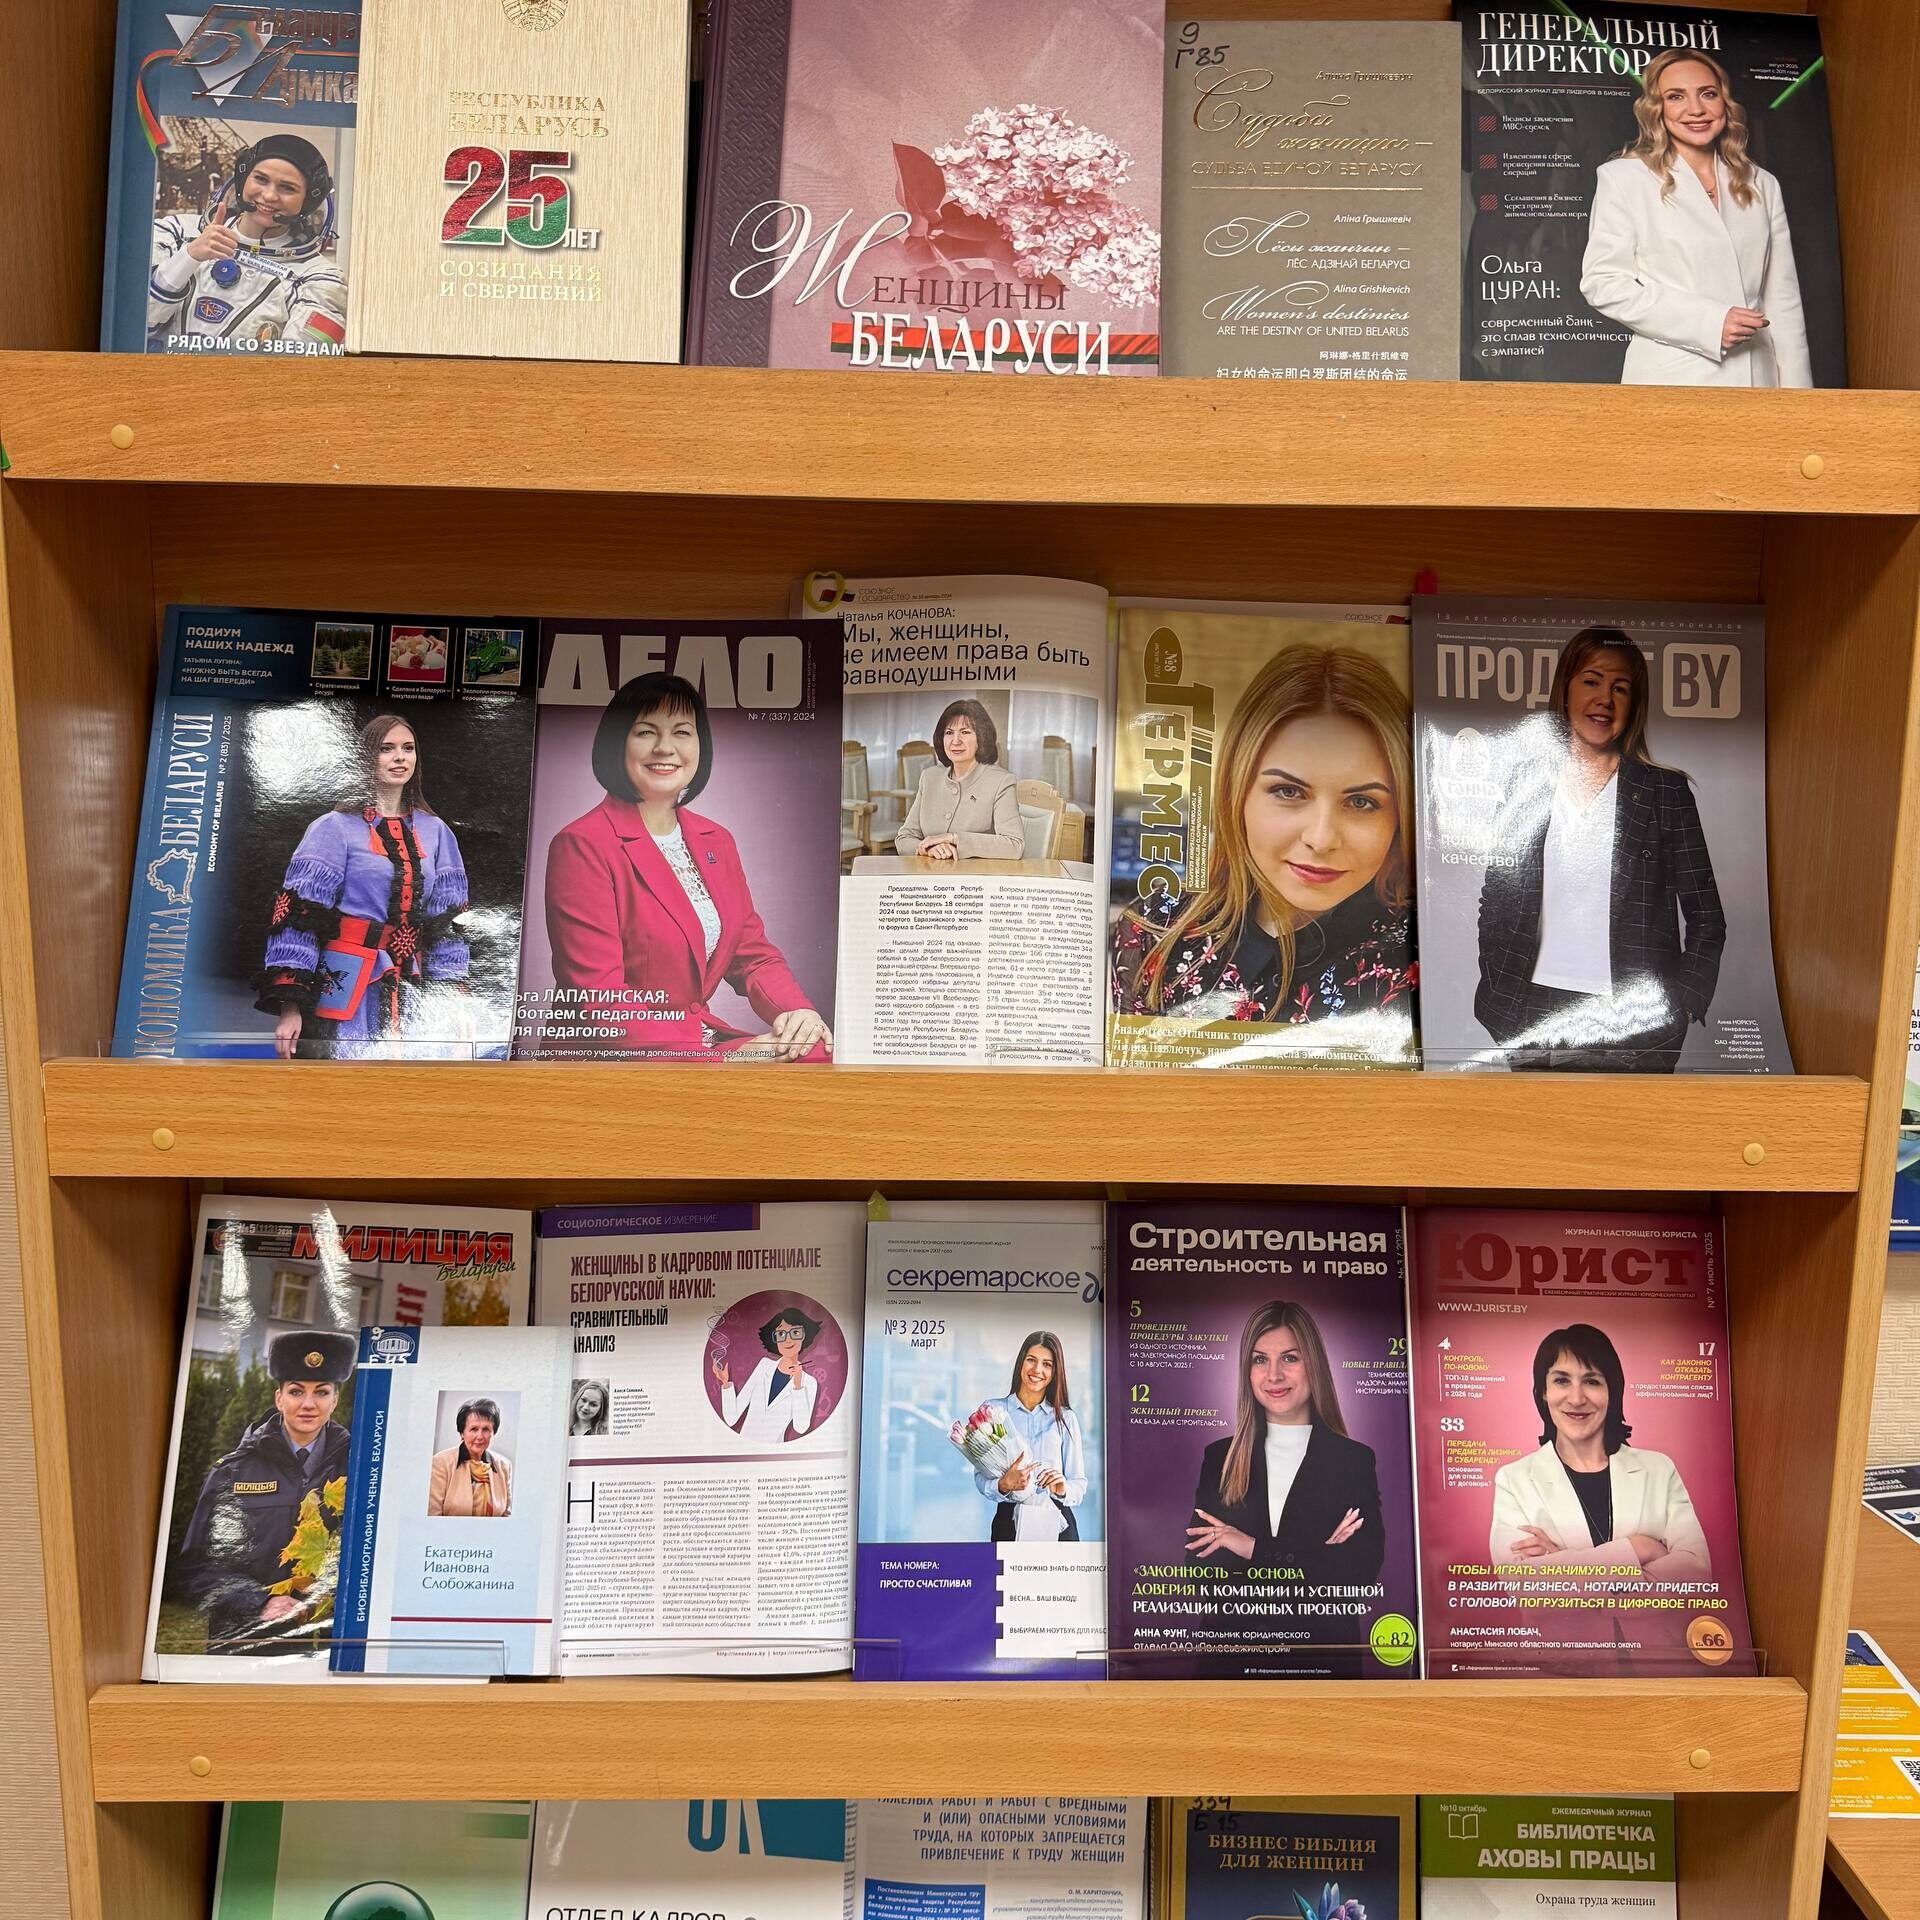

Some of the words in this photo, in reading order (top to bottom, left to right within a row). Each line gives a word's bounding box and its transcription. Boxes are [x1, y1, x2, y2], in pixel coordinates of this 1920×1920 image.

[1180, 22, 1199, 44] 9
[1478, 12, 1721, 50] ГЕНЕРАЛЬНЫЙ
[1477, 44, 1651, 78] ДИРЕКТОР
[448, 91, 606, 112] РЕСПУБЛИКА
[448, 112, 609, 137] БЕЛАРУСЬ
[1263, 160, 1332, 176] ЕДИНОЙ
[1339, 162, 1423, 176] БЕЛАРУСИ
[441, 145, 570, 249] 25
[562, 228, 601, 250] ЛЕТ
[1334, 214, 1360, 223] Аліна
[1363, 215, 1411, 224] Грышкевіч
[440, 259, 602, 282] СОЗИДАНИЯ
[1311, 258, 1357, 270] АДЗІНАЙ
[1361, 259, 1410, 269] БЕЛАРУСІ
[1481, 255, 1542, 275] Ольга
[463, 281, 602, 302] СВЕРШЕНИЙ
[1334, 285, 1357, 293] Alina
[1359, 285, 1410, 294] Grishkevich
[1481, 280, 1562, 305] ЦУРАН:
[1203, 281, 1329, 321] Women's
[1323, 304, 1409, 320] destinies
[1217, 326, 1235, 335] ARE
[1241, 326, 1259, 336] THE
[1263, 326, 1303, 336] DESTINY
[1307, 326, 1322, 336] OF
[1326, 326, 1361, 336] UNITED
[1366, 327, 1409, 336] BELARUS
[1481, 316, 1563, 332] современный
[1566, 314, 1592, 327] банк
[168, 335, 231, 352] РЯДОМ
[850, 311, 1111, 375] БЕЛАРУСИ
[1481, 332, 1500, 343] это
[1504, 331, 1536, 342] сплав
[1539, 331, 1635, 342] технологичности
[1491, 345, 1545, 356] эмпатией
[837, 611, 884, 622] Наталья
[888, 608, 956, 620] КОЧАНОВА:
[186, 627, 241, 638] ПОДИУМ
[889, 622, 1009, 641] женщины,
[185, 638, 232, 651] НАШИХ
[236, 641, 295, 655] НАДЕЖД
[871, 646, 948, 662] имеем
[957, 644, 1028, 663] права
[1037, 640, 1090, 666] быть
[1672, 653, 1731, 708] BY
[769, 713, 790, 721] (337)
[793, 713, 815, 721] 2024
[159, 713, 214, 847] БЕЛАРУСИ
[208, 838, 218, 872] ECONOMY
[214, 780, 224, 818] BELARUS
[1441, 852, 1520, 868] качество!
[542, 989, 670, 1004] ЛАПАТИНСКАЯ:
[591, 1010, 685, 1021] педагогами
[594, 1049, 645, 1057] учреждения
[558, 1216, 662, 1229] СОЦИОЛОГИЧЕСКОЕ
[664, 1215, 717, 1224] ИЗМЕРЕНИЕ
[1129, 1223, 1387, 1254] Строительная
[1565, 1228, 1601, 1236] ЖУРНАЛ
[1603, 1229, 1660, 1238] НАСТОЯЩЕГО
[292, 1225, 513, 1265] МИЛИЦИЯ
[570, 1253, 644, 1277] ЖЕНЩИНЫ
[661, 1250, 732, 1275] КАДРОВОМ
[737, 1248, 822, 1270] ПОТЕНЦИАЛЕ
[1130, 1258, 1292, 1274] деятельность
[1303, 1261, 1316, 1273] и
[1324, 1261, 1388, 1277] право
[435, 1261, 516, 1282] Беларуси
[887, 1269, 1080, 1291] секретарское
[570, 1274, 664, 1303] БЕЛОРУССКОЙ
[669, 1278, 715, 1299] НАУКИ:
[1130, 1301, 1141, 1317] 5
[1438, 1302, 1527, 1313] WWW.JURIST.BY
[912, 1321, 945, 1335] 2025
[911, 1339, 937, 1349] март
[1698, 1342, 1715, 1355] 17
[1130, 1384, 1149, 1402] 12
[1184, 1408, 1218, 1417] ПРОЕКТ
[1441, 1418, 1464, 1431] 33
[372, 1410, 385, 1462] БЕЛАРУСИ
[368, 1465, 380, 1510] УЧЕНЫХ
[425, 1546, 493, 1560] Екатерина
[356, 1514, 374, 1622] БИОБИБЛИОГРАФИЯ
[423, 1561, 490, 1574] Ивановна
[904, 1562, 939, 1570] НОМЕРА:
[1134, 1565, 1228, 1578] «ЗАКОННОСТЬ
[1247, 1568, 1304, 1579] ОСНОВА
[1448, 1565, 1492, 1575] ЧТОБЫ
[1494, 1565, 1537, 1575] ИГРАТЬ
[1539, 1565, 1606, 1575] ЗНАЧИМУЮ
[1610, 1565, 1642, 1575] РОЛЬ
[422, 1577, 514, 1591] Слобожанина
[880, 1580, 915, 1588] ПРОСТО
[916, 1580, 971, 1588] СЧАСТЛИВАЯ
[1132, 1582, 1195, 1596] ДОВЕРИЯ
[1214, 1585, 1289, 1597] КОМПАНИИ
[1308, 1584, 1384, 1597] УСПЕШНОЙ
[1459, 1581, 1521, 1591] РАЗВИТИИ
[1523, 1581, 1581, 1593] БИЗНЕСА,
[1584, 1582, 1652, 1593] НОТАРИАТУ
[1656, 1582, 1719, 1593] ПРИДЕТСЯ
[1134, 1628, 1160, 1637] АННА
[1163, 1628, 1189, 1639] ФУНТ,
[1192, 1630, 1241, 1639] начальник
[1243, 1630, 1310, 1640] юридического
[1450, 1627, 1504, 1636] АНАСТАСИЯ
[1507, 1627, 1541, 1637] ЛОБАЧ,
[1552, 1807, 1614, 1816] ЕЖЕМЕСЯЧНЫЙ
[1617, 1809, 1651, 1817] ЖУРНАЛ
[914, 1830, 953, 1843] ТРУДА,
[981, 1831, 1034, 1842] КОТОРЫХ
[1042, 1832, 1125, 1847] ЗАПРЕЩАЕТСЯ
[1517, 1824, 1655, 1841] БИБЛИОТЕЧКА
[1208, 1835, 1288, 1849] БИЗНЕС
[1294, 1837, 1376, 1853] БИБЛИЯ
[921, 1848, 1004, 1860] ПРИВЛЕЧЕНИЕ
[1028, 1849, 1063, 1862] ТРУДУ
[1071, 1850, 1124, 1863] ЖЕНЩИН
[1220, 1854, 1261, 1869] ДЛЯ
[1268, 1856, 1365, 1872] ЖЕНЩИН
[1478, 1849, 1561, 1868] АХОВЫ
[1570, 1850, 1655, 1873] ПРАЦЫ
[1535, 1893, 1575, 1905] Охрана
[1578, 1895, 1608, 1906] труда
[1611, 1895, 1655, 1907] женщин
